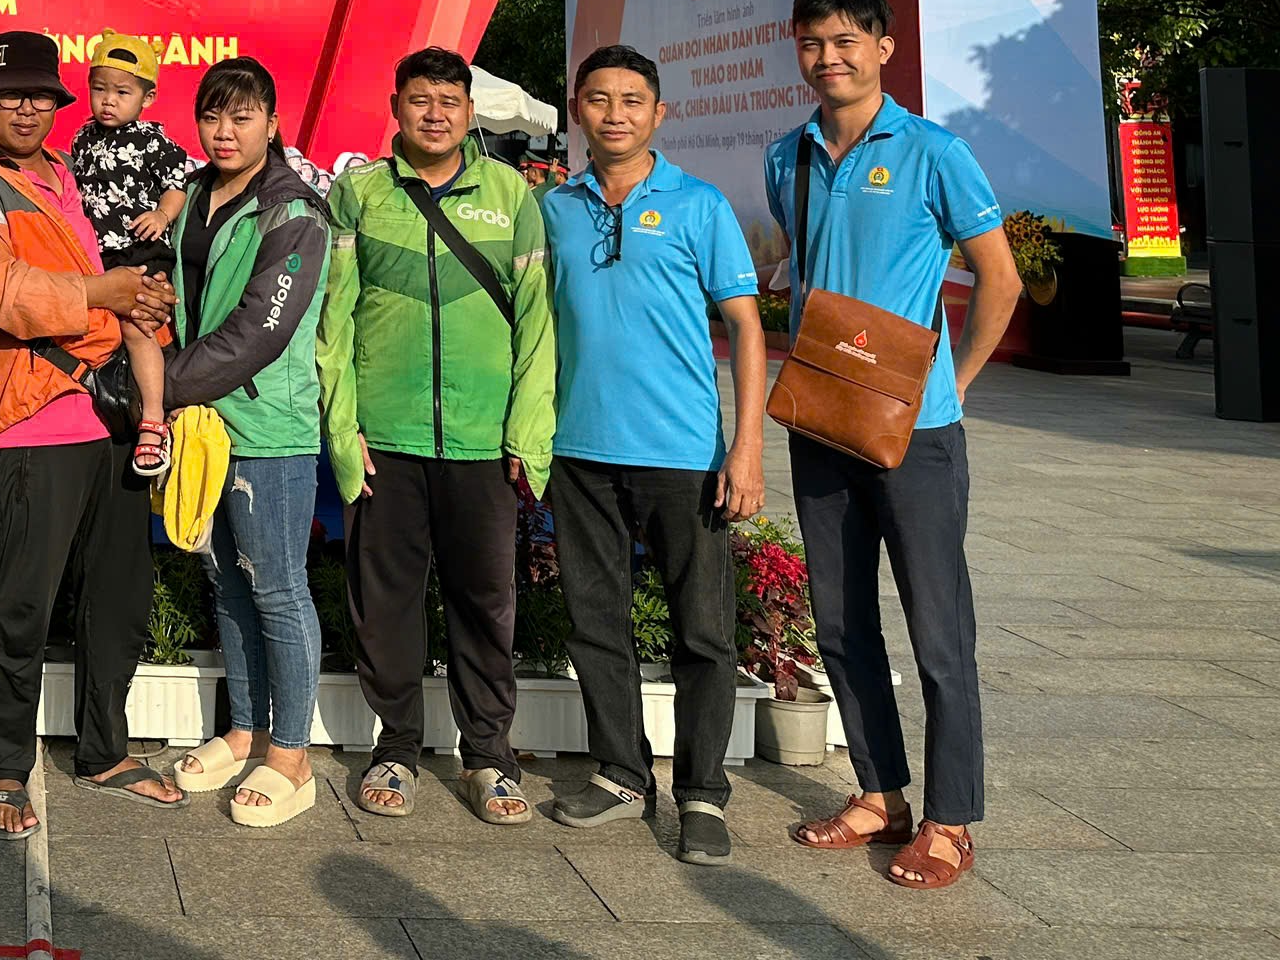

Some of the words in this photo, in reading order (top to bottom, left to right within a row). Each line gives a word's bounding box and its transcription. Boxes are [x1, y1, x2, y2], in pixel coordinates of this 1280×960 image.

[727, 64, 738, 83] 80
[737, 131, 745, 145] 19
[765, 129, 772, 144] 12
[456, 202, 510, 229] Grab
[262, 273, 293, 332] gojek
